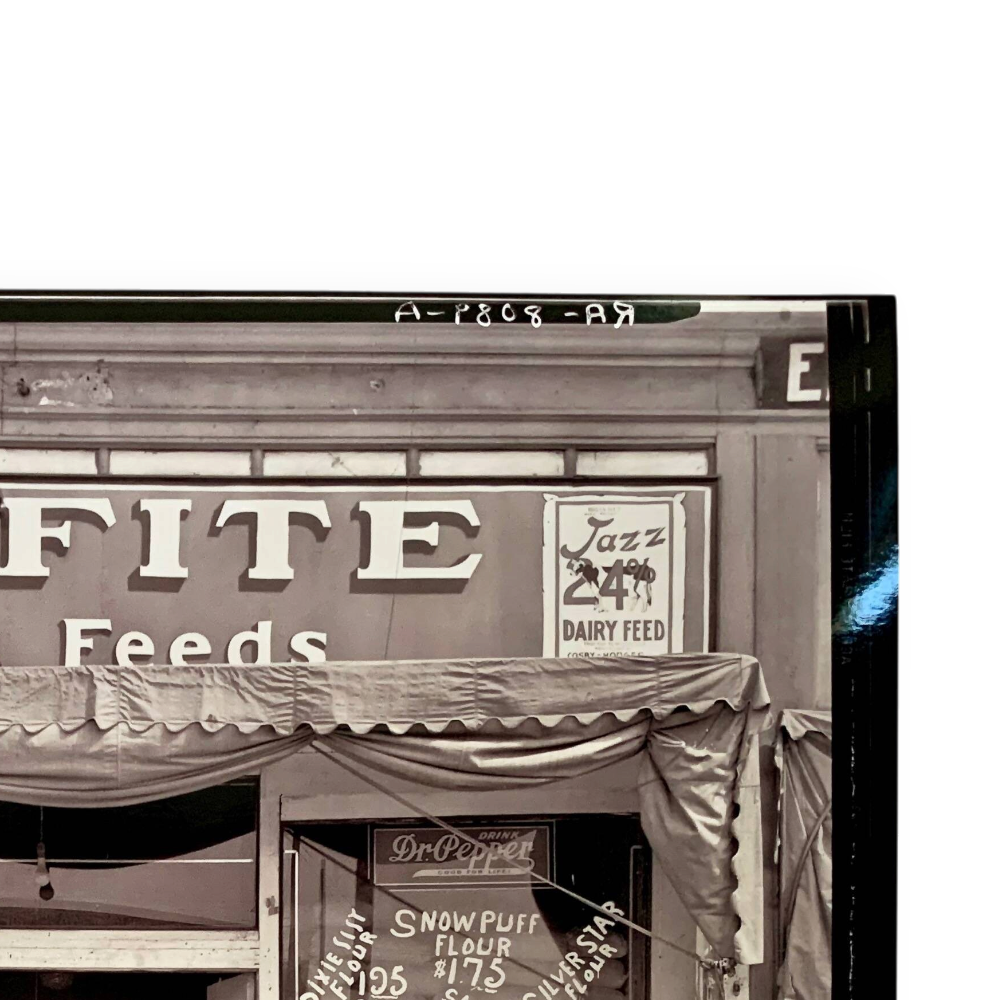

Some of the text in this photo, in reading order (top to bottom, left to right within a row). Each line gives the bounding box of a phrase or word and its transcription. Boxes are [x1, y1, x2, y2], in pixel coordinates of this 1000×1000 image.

[560, 516, 666, 560] Jazz
[64, 618, 328, 667] Feeds
[563, 619, 665, 641] DAIRY FEED
[479, 831, 519, 840] DRINK
[480, 910, 540, 934] PUFF
[576, 901, 625, 954] STAR
[435, 934, 511, 957] FLOUR
[330, 931, 378, 1000] FLOUR
[434, 957, 505, 988] $1.75
[564, 943, 618, 1000] FLOUR
